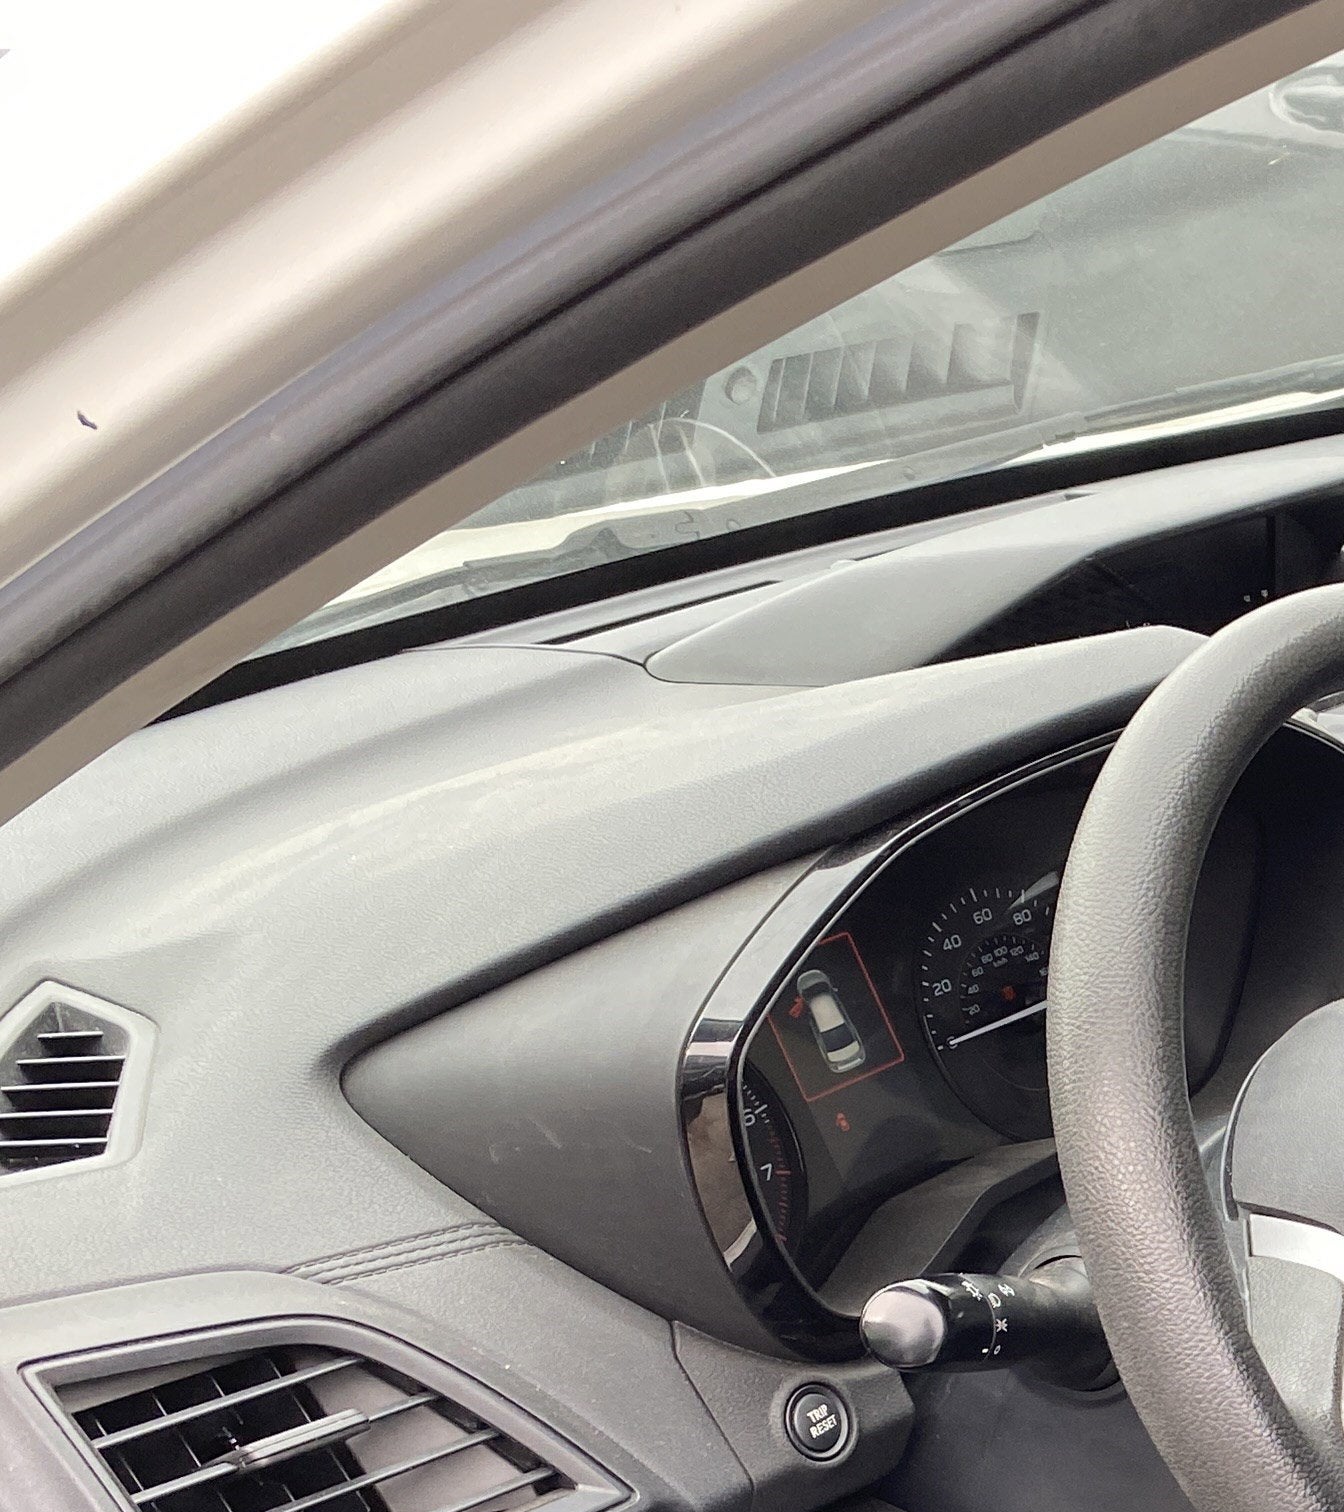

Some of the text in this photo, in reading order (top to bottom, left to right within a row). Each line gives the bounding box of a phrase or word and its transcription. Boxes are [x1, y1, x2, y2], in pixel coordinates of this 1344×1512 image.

[973, 908, 993, 925] 60
[1012, 909, 1033, 926] 80
[943, 934, 962, 951] 40
[980, 953, 994, 964] 80
[971, 966, 984, 978] 60
[932, 978, 952, 997] 20
[967, 984, 980, 995] 40
[968, 1003, 981, 1016] 20
[743, 1108, 756, 1127] 6
[760, 1163, 773, 1182] 7
[806, 1403, 829, 1424] TRIP
[809, 1413, 838, 1439] RESET
